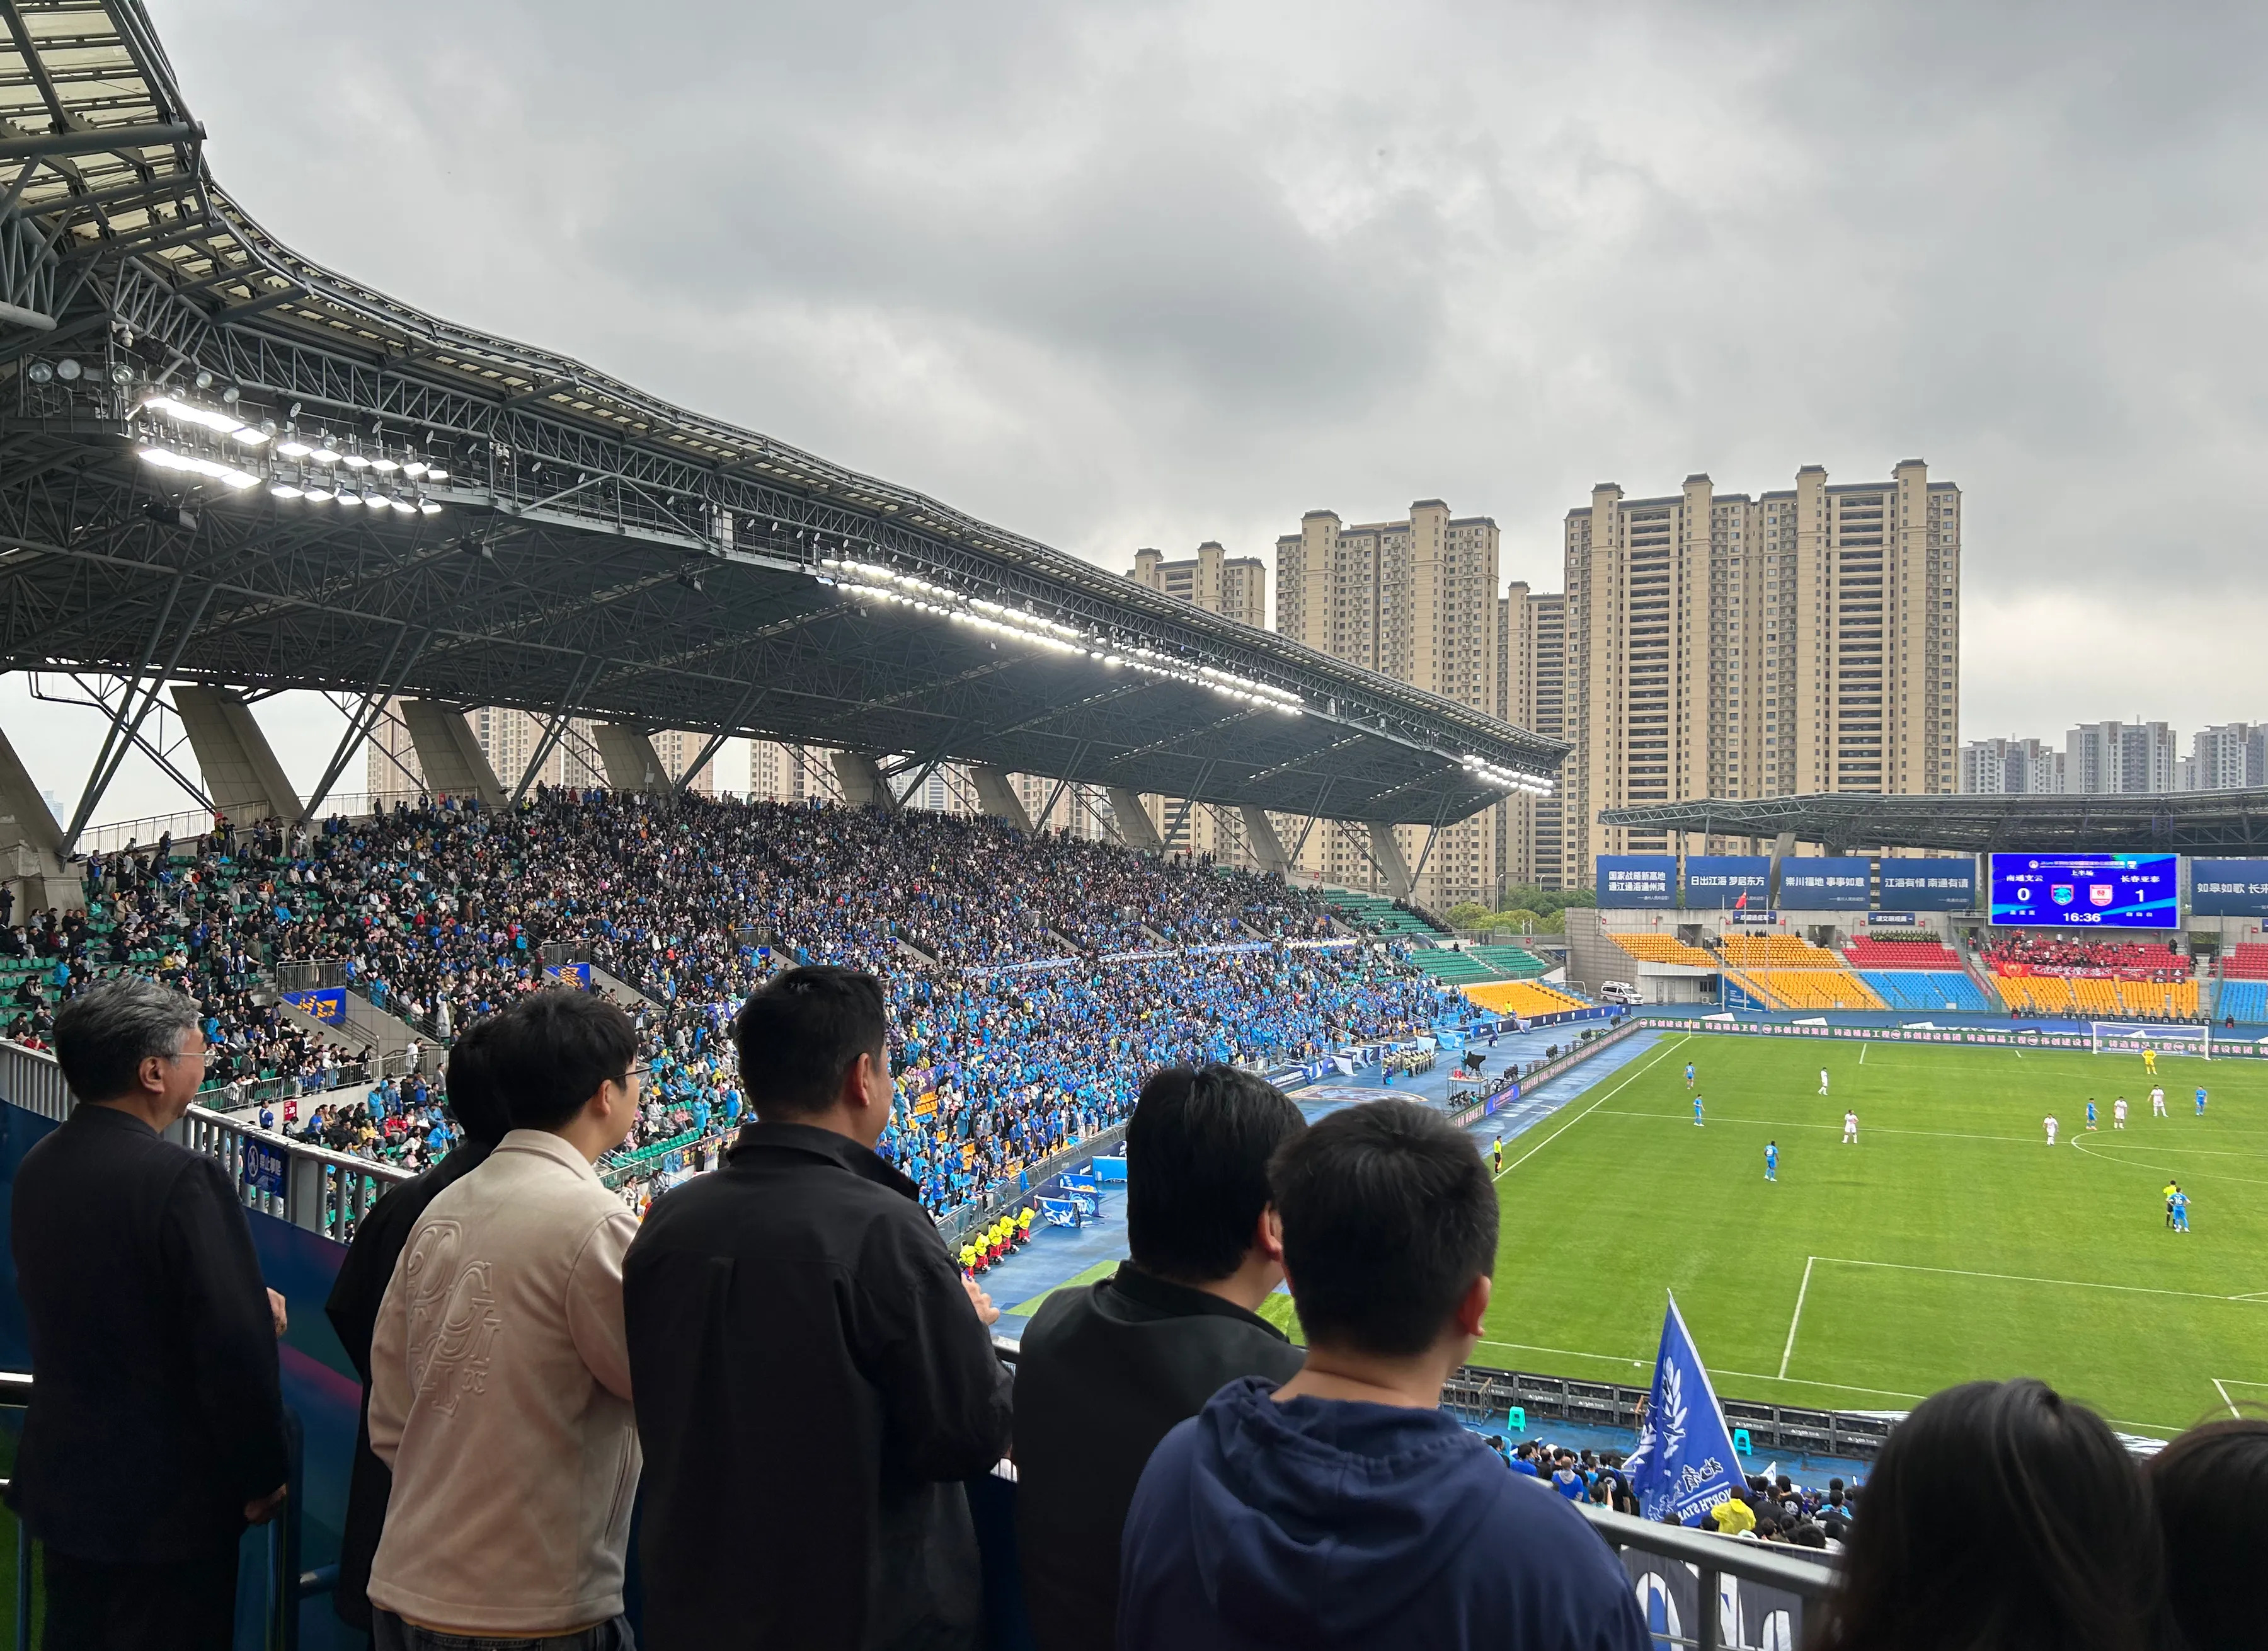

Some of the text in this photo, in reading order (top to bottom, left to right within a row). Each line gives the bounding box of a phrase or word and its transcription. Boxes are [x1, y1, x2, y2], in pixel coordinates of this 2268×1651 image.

[1608, 871, 1666, 880] 国家战略新高地
[1691, 876, 1765, 887] 日出江海 梦启东方
[1785, 877, 1824, 887] 崇川福地
[1884, 878, 1925, 888] 江海有情
[1608, 882, 1666, 892] 通江通海通州湾
[2197, 883, 2245, 894] 如皋如歌
[2017, 887, 2030, 901] 0
[2135, 889, 2144, 902] 1
[2063, 912, 2101, 922] 16:36
